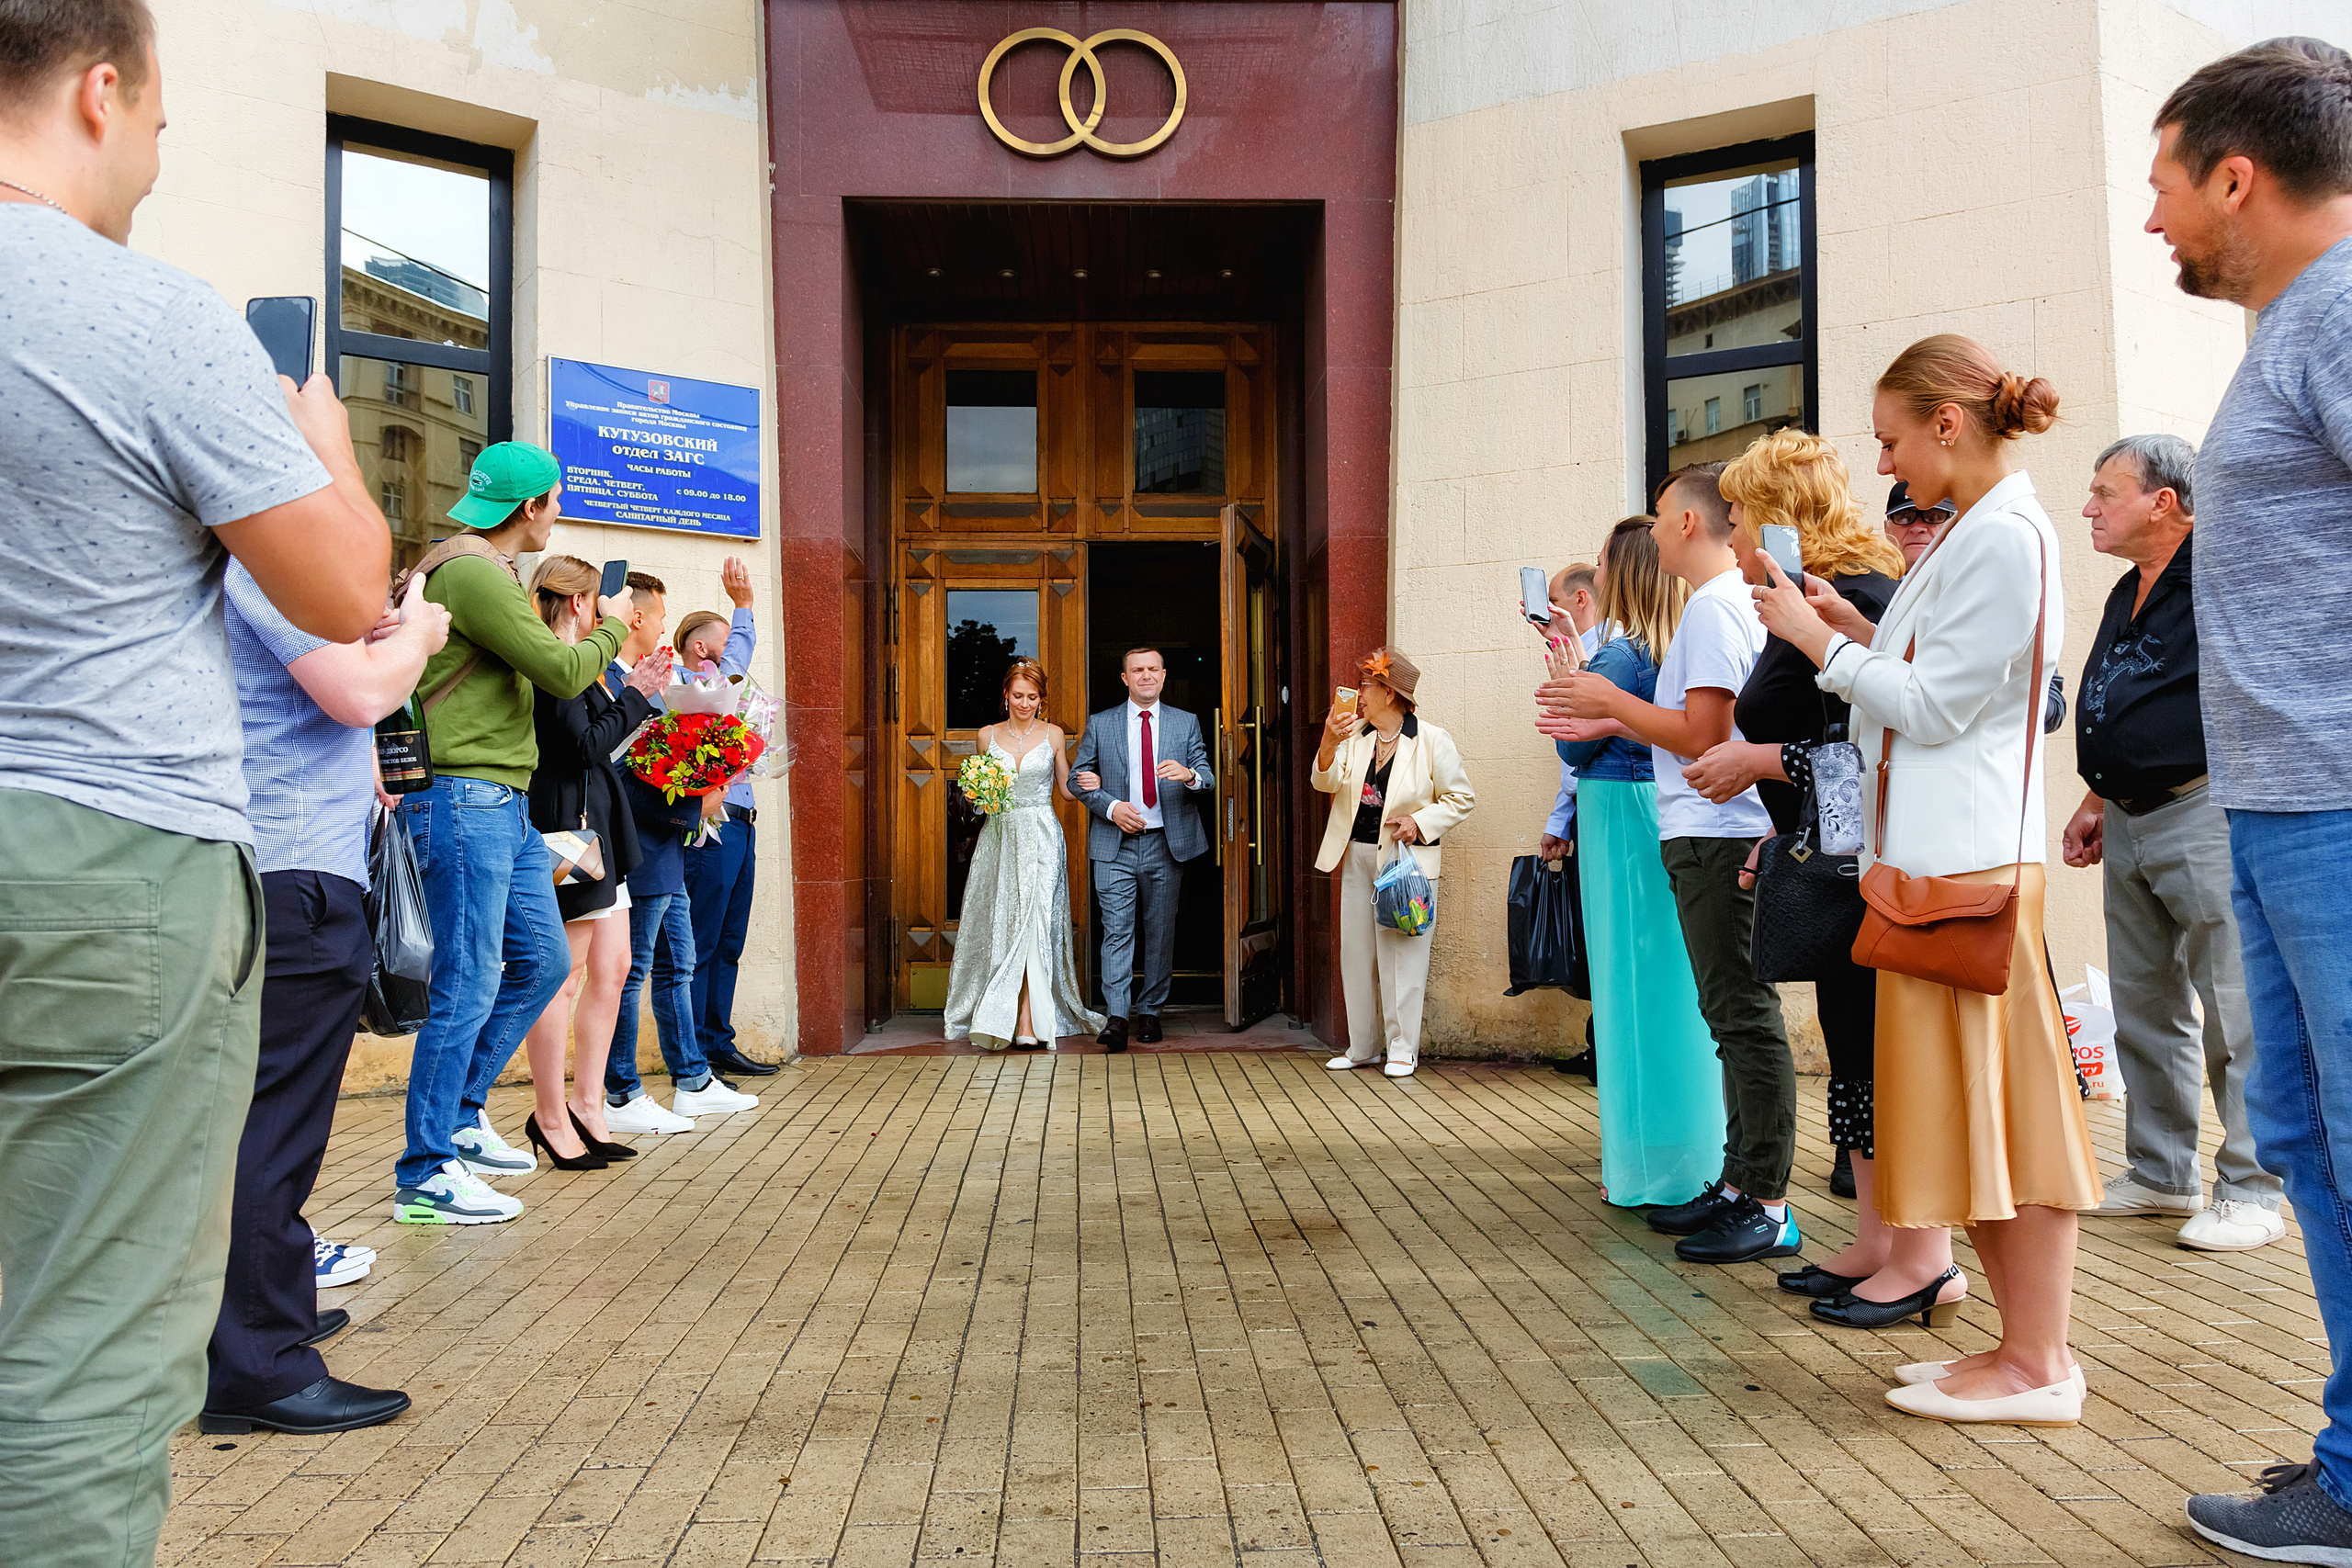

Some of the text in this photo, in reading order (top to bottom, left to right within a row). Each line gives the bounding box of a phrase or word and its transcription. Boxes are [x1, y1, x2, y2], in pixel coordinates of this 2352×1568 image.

[565, 400, 610, 412] Управление
[611, 408, 637, 416] записи
[661, 414, 710, 426] гражданского
[712, 423, 748, 432] состояния
[616, 401, 700, 418] Правительство Москвы
[631, 417, 686, 429] города Москвы
[598, 425, 718, 452] КУТУЗОВСКИЙ
[612, 445, 705, 465] отдел ЗАГС
[627, 463, 691, 478] ЧАСЫ РАБОТЫ
[616, 490, 659, 501] СУББОТА
[683, 489, 708, 498] 09.00
[722, 493, 747, 502] 18.00
[583, 499, 731, 521] ЧЕТВЕРТЫЙ ЧЕТВЕРГ КАЖДОГО МЕСЯЦА
[616, 511, 702, 526] САНИТАРНЫЙ ДЕНЬ
[2080, 1066, 2098, 1076] rry
